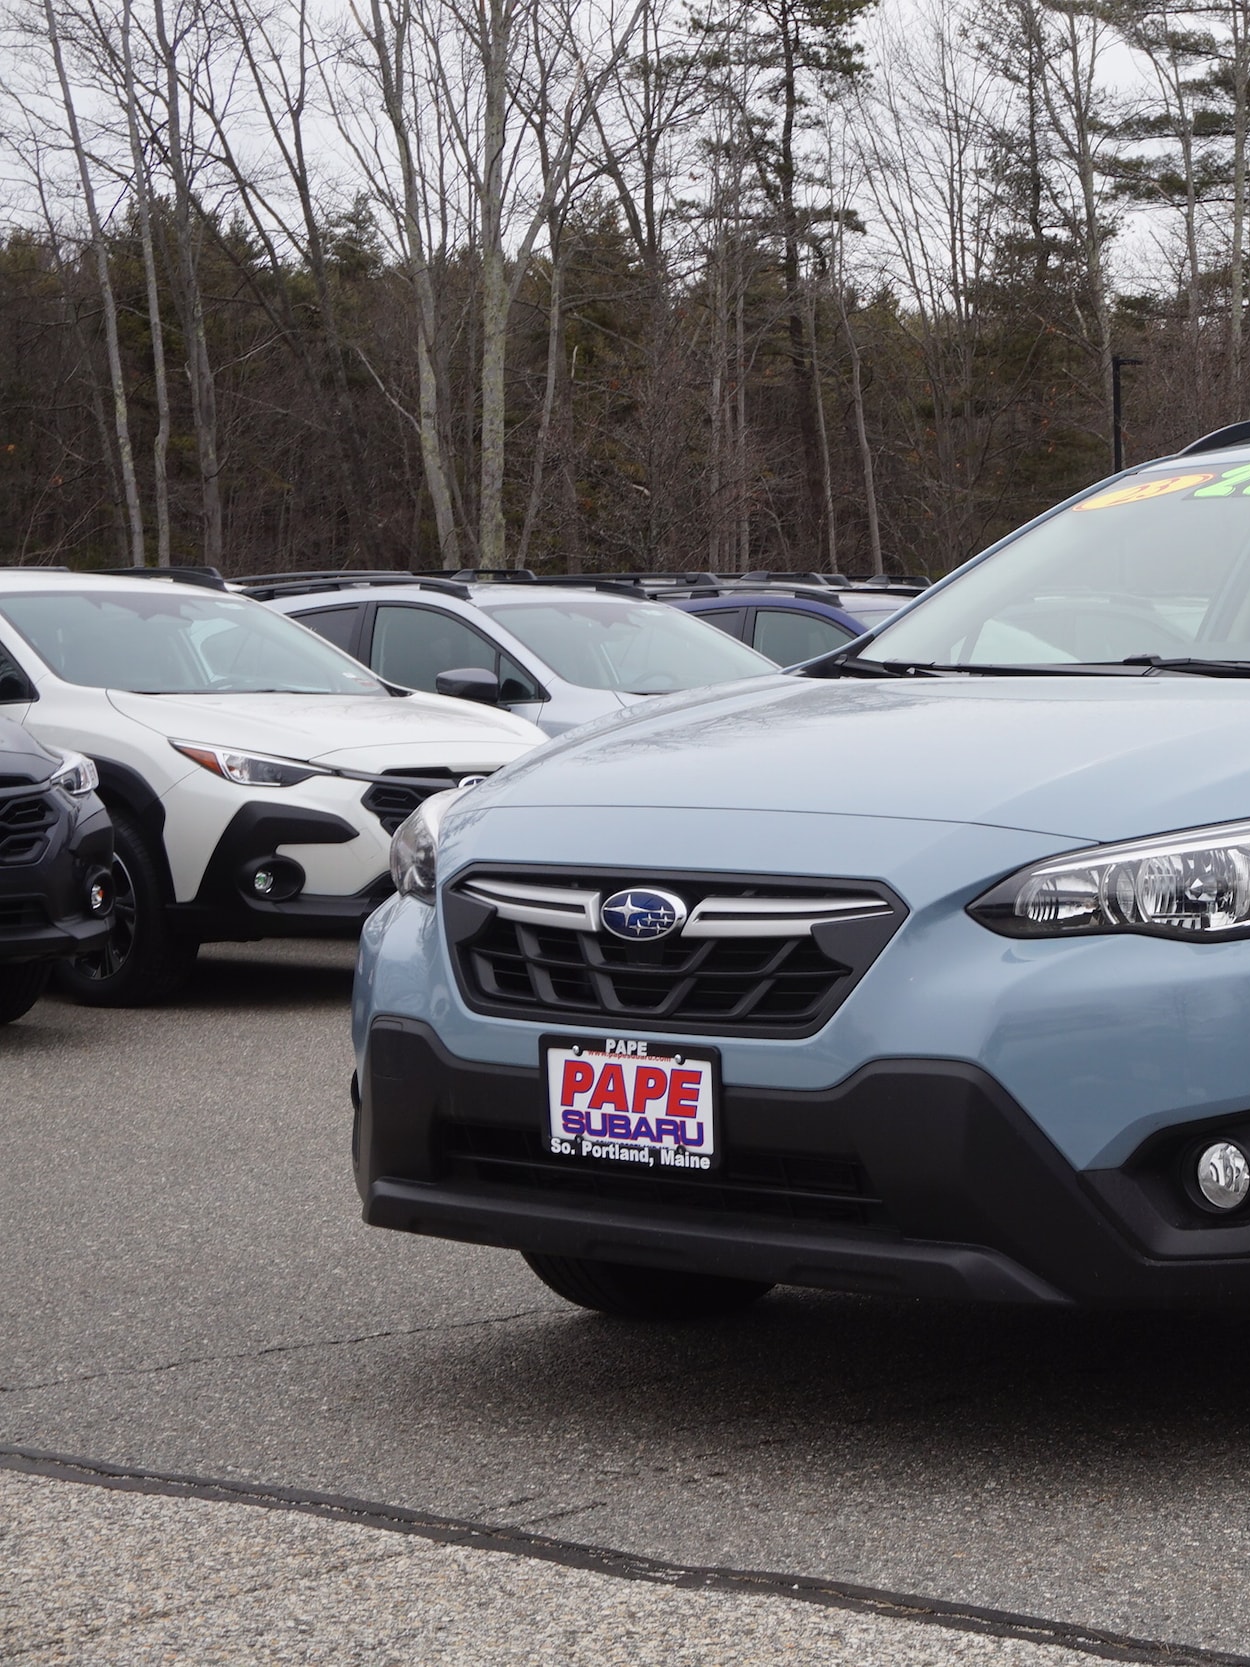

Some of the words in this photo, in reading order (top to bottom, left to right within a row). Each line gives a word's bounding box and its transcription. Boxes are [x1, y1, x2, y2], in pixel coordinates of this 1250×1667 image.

[606, 1039, 647, 1056] PAPE
[561, 1060, 702, 1118] PAPE
[562, 1109, 704, 1147] SUBARU
[551, 1138, 576, 1154] So.
[582, 1141, 654, 1167] Portland,
[661, 1149, 711, 1169] Maine
